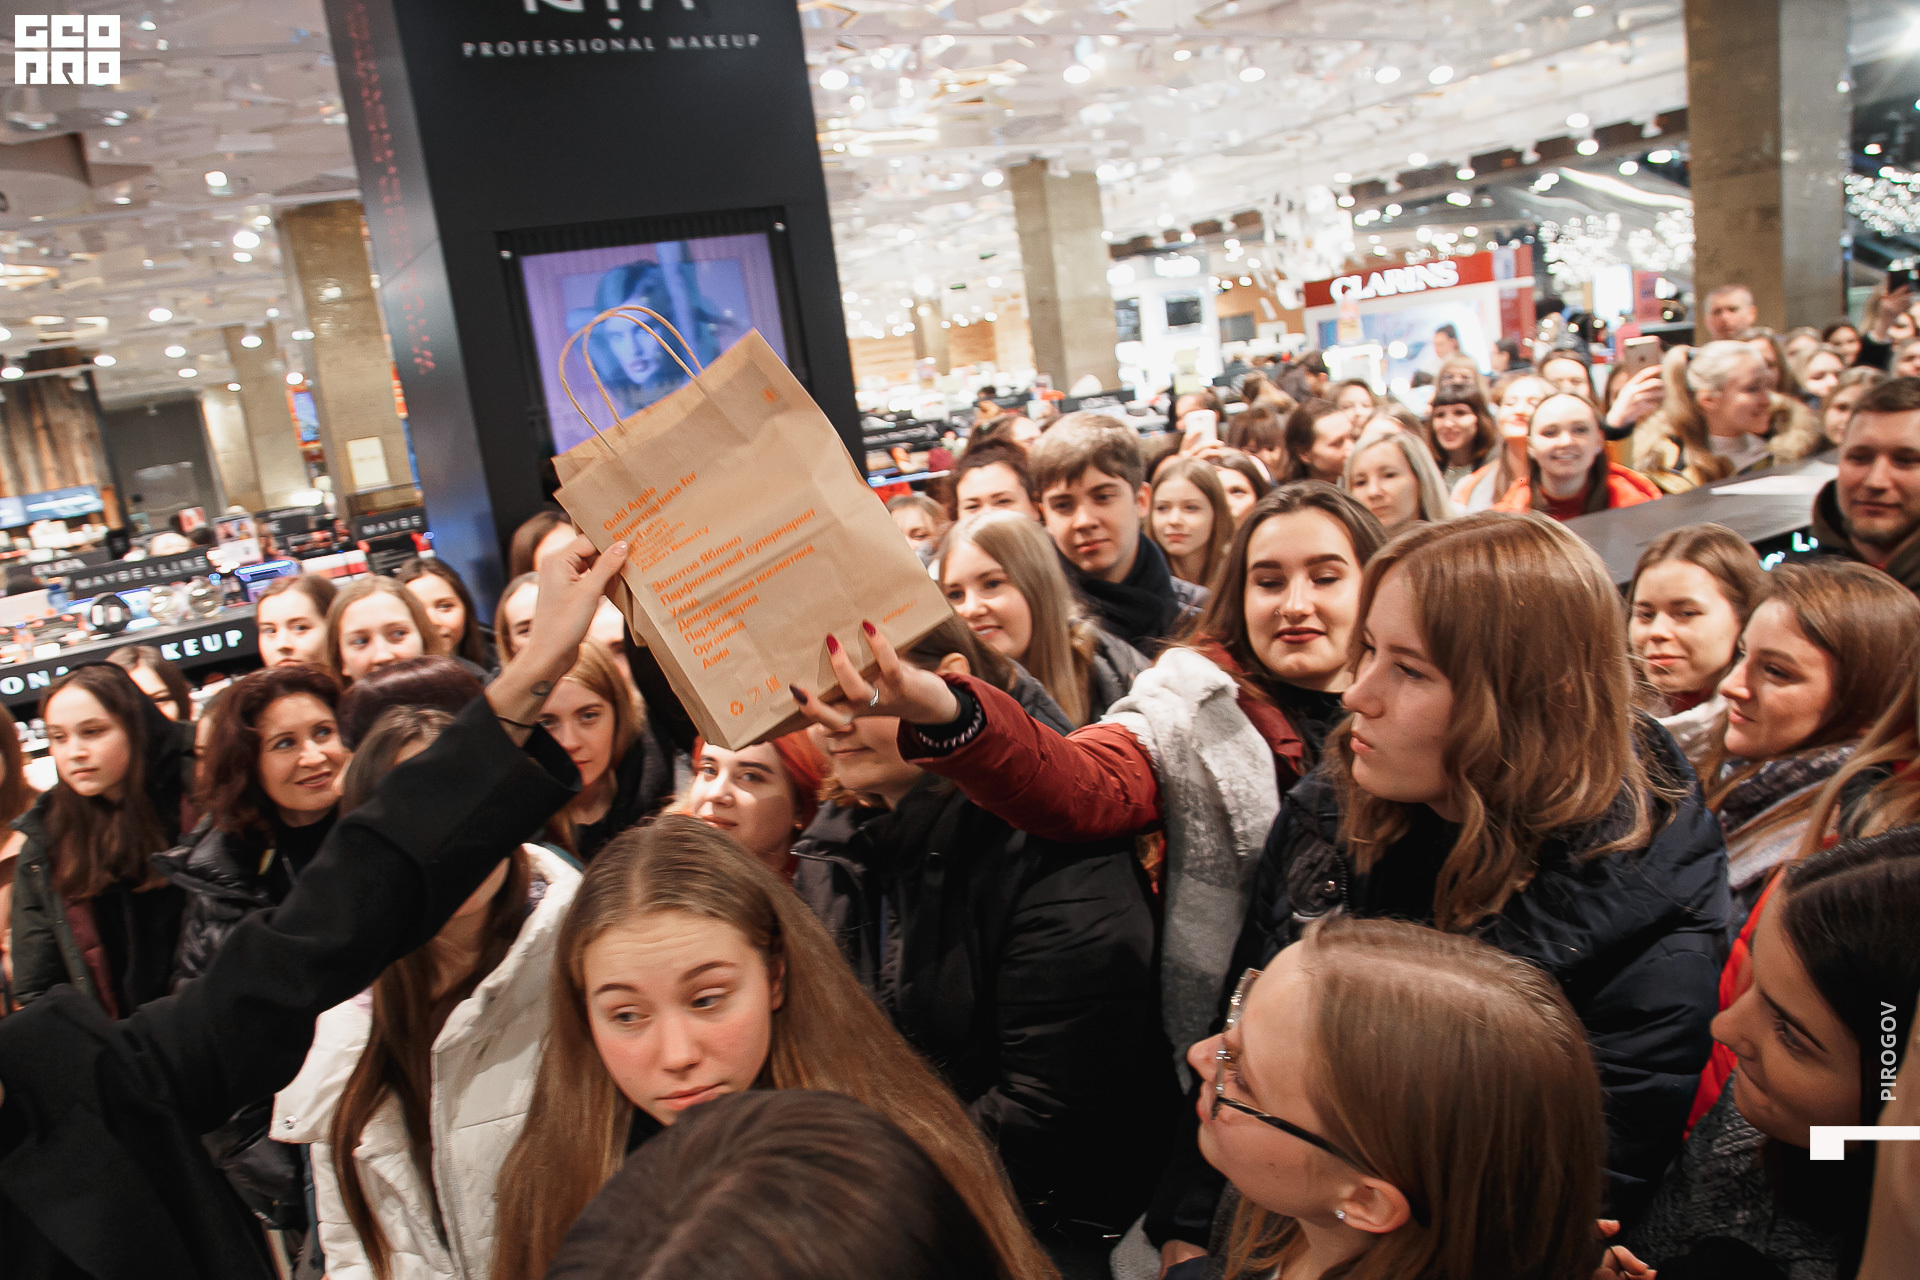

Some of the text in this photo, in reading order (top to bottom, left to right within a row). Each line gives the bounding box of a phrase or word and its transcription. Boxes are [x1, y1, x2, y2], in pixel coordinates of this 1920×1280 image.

[461, 33, 760, 58] PROFESSIONAL MAKEUP
[1329, 260, 1460, 303] CLARINS
[603, 486, 657, 531] Gold Apple
[612, 471, 697, 542] Supermarkets for
[74, 555, 208, 590] MAYBELLINE
[652, 536, 743, 593] Золотое Яблоко
[660, 508, 816, 606] Парфюмерный супермаркет
[669, 597, 700, 619] Уход
[677, 544, 815, 634] Декоративная косметика
[684, 594, 760, 645] Парфюмерия
[692, 620, 746, 657] Органика
[701, 647, 730, 671] Азия
